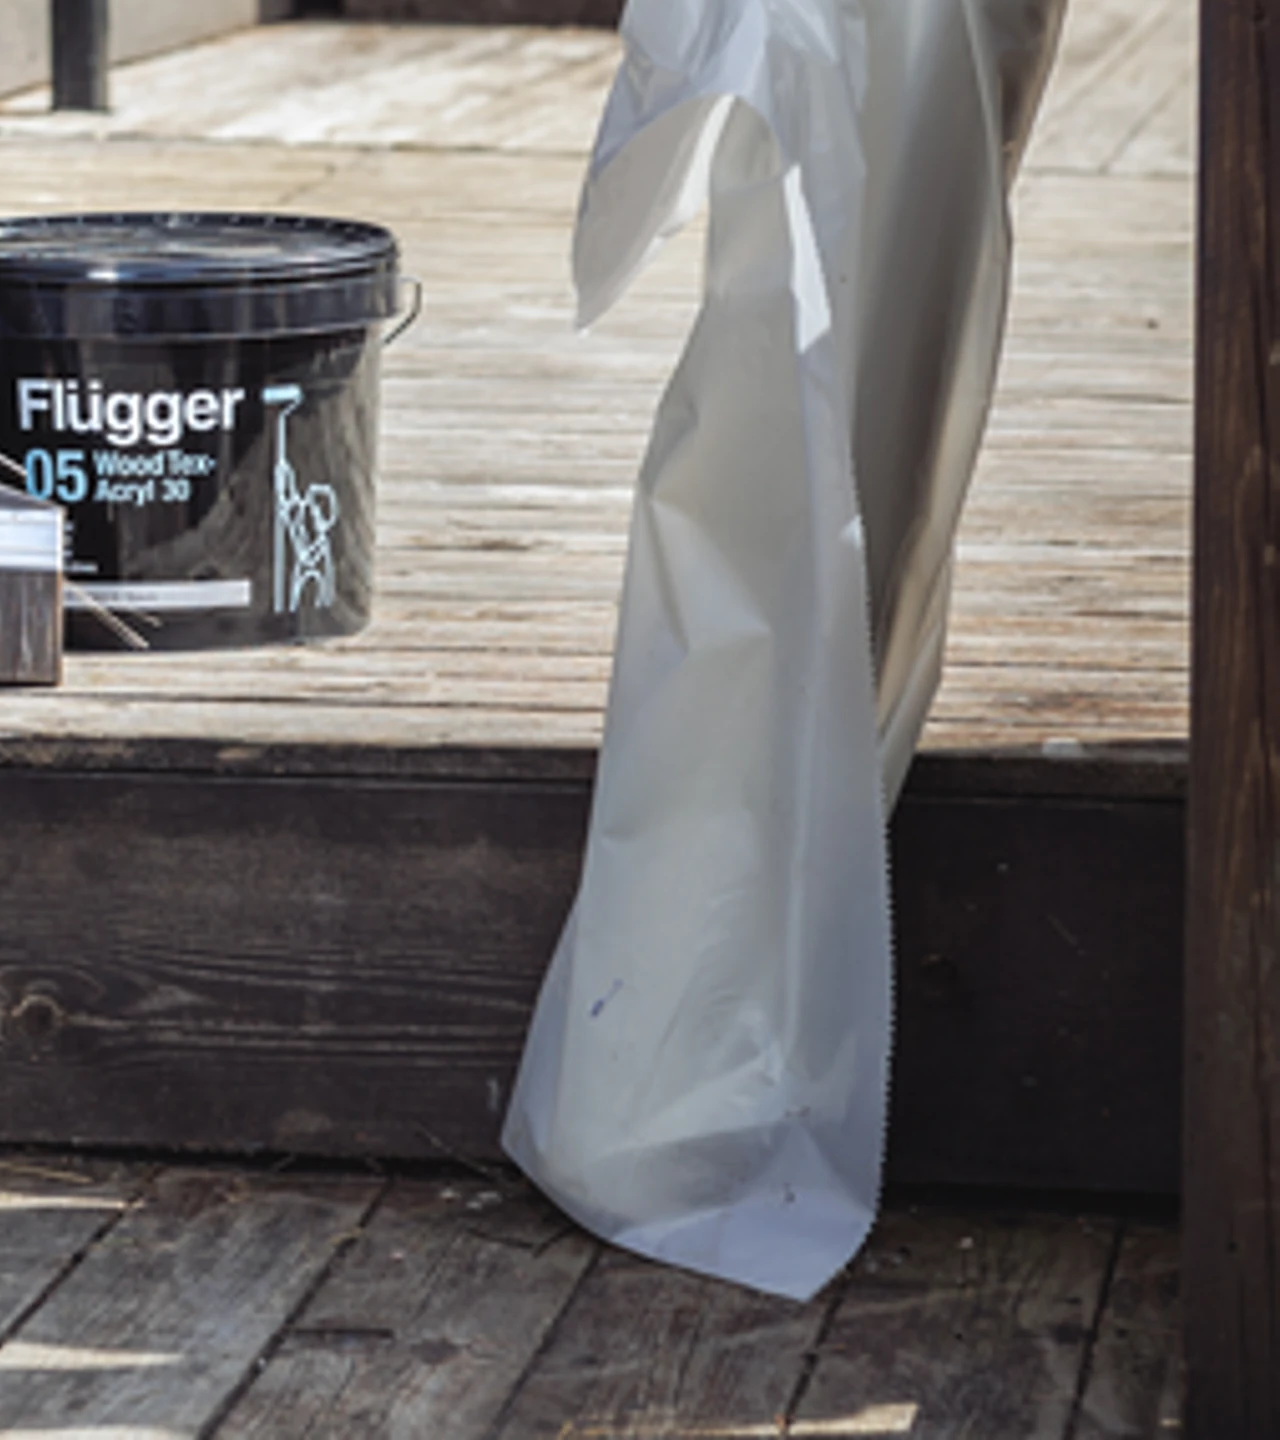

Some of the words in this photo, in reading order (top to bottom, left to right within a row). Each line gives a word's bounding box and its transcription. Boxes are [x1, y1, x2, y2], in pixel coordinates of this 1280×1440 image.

[17, 378, 245, 446] Flügger
[25, 447, 89, 502] 05
[93, 478, 155, 506] Acryl
[162, 478, 191, 502] 30
